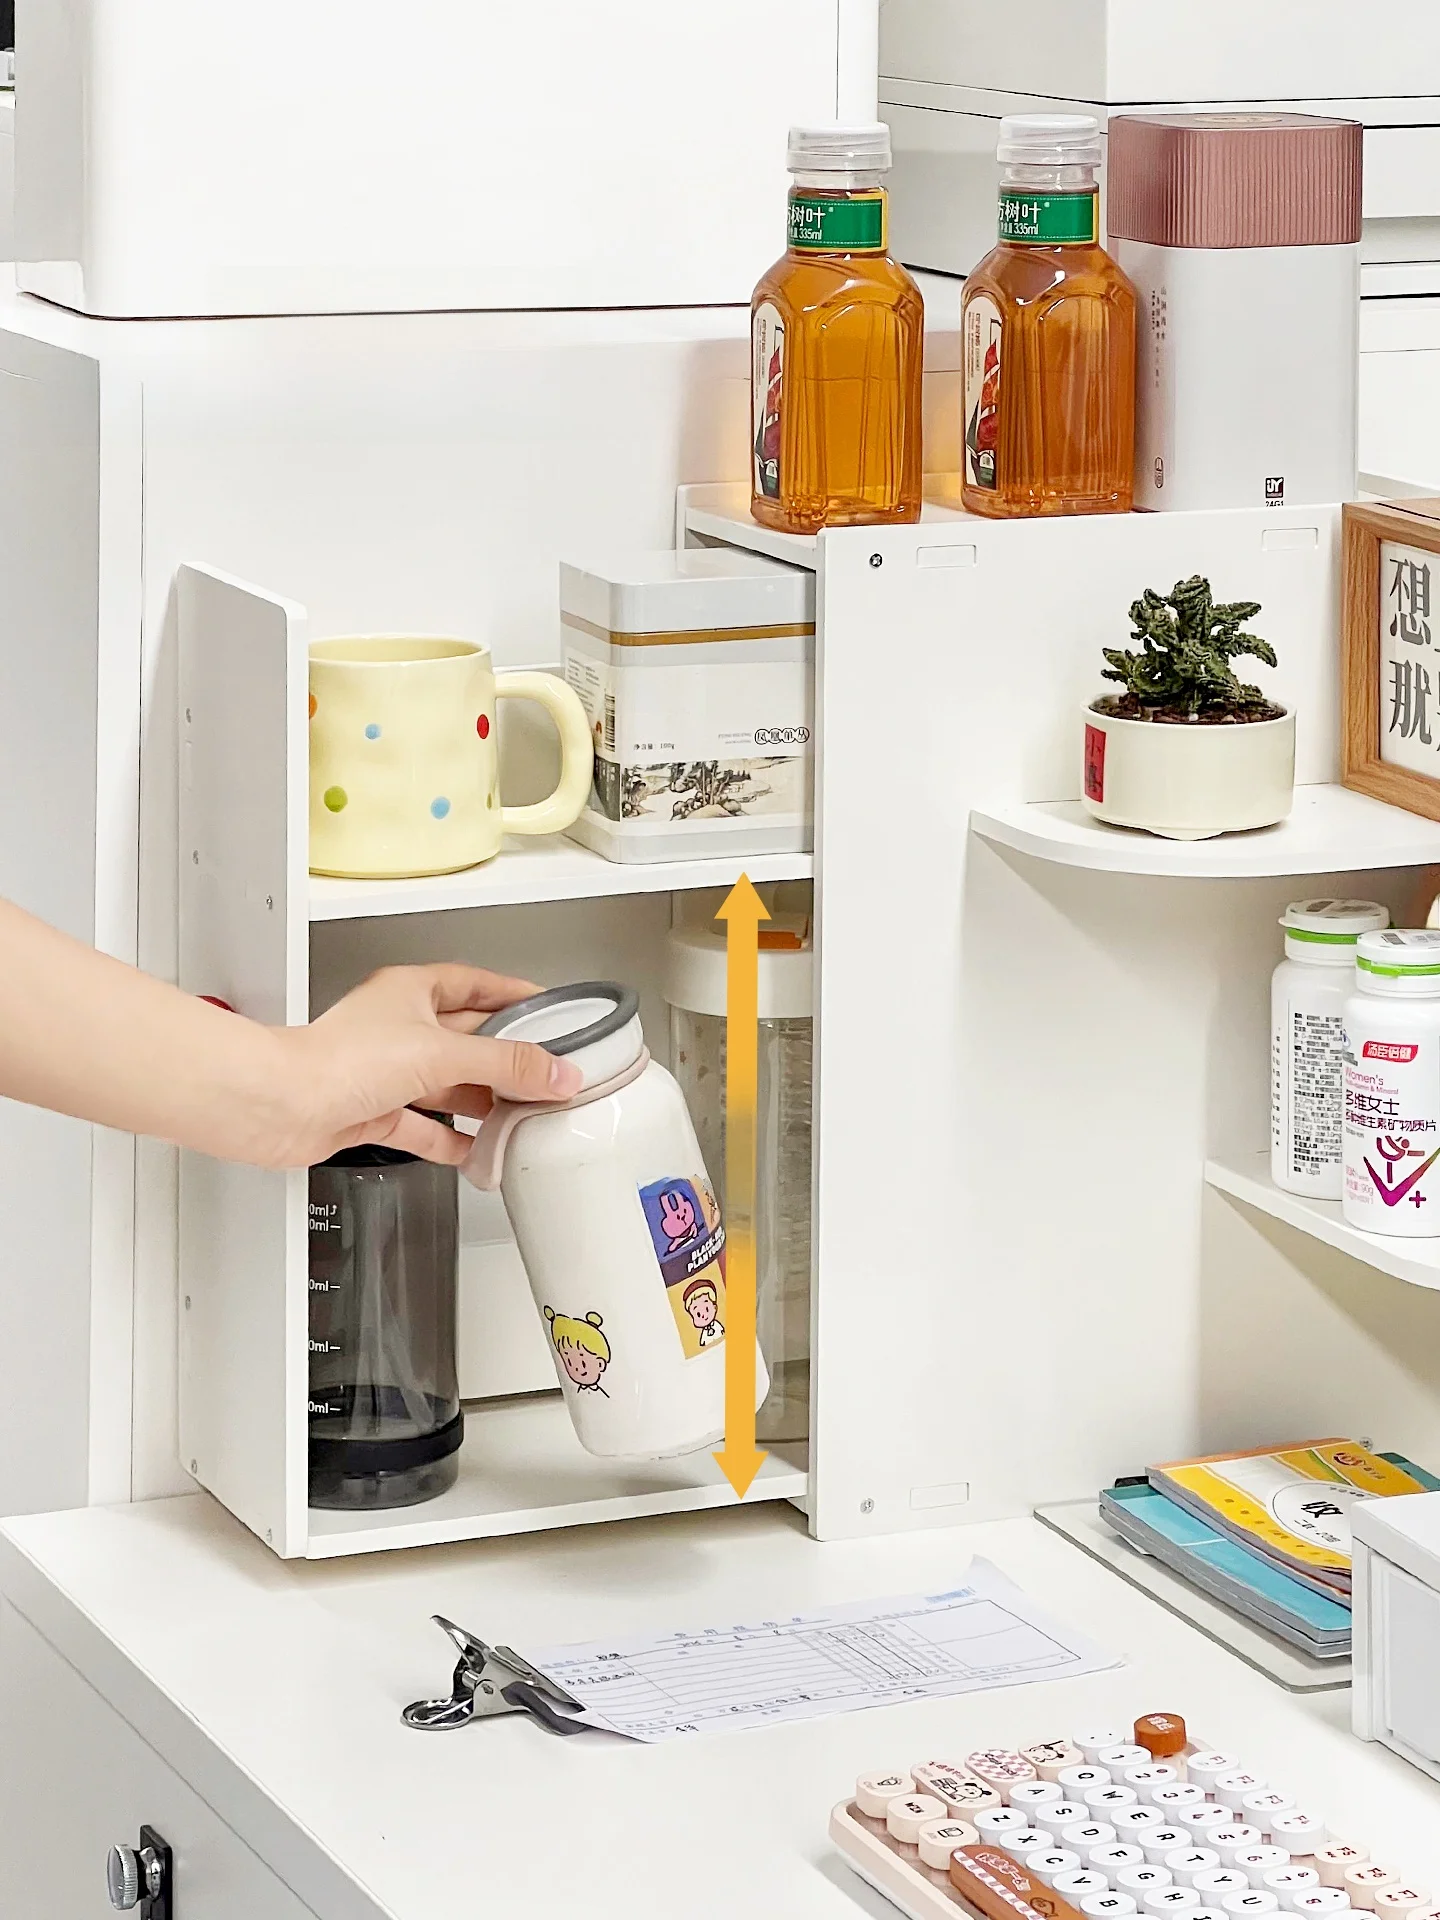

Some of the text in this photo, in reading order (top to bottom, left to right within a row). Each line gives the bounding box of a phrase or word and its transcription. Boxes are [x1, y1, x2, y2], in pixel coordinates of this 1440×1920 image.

[1013, 222, 1039, 235] 335ml
[799, 228, 822, 240] 335ml
[1389, 558, 1432, 646] 想
[1367, 1043, 1412, 1060] 汤臣倍健
[1345, 1066, 1384, 1086] Women's
[1345, 1089, 1400, 1115] 多维女士
[1027, 1788, 1045, 1796] A
[1102, 1790, 1124, 1799] W
[992, 1814, 1011, 1822] Z
[1130, 1811, 1150, 1820] E
[1081, 1828, 1099, 1836] D
[1156, 1832, 1176, 1841] R
[1017, 1835, 1037, 1843] X
[1109, 1849, 1128, 1858] F
[1186, 1854, 1205, 1862] T
[1072, 1876, 1092, 1884] V
[1138, 1872, 1155, 1880] G
[1213, 1875, 1232, 1883] Y
[1164, 1892, 1184, 1901] H
[1242, 1896, 1262, 1905] U
[1099, 1899, 1118, 1908] B
